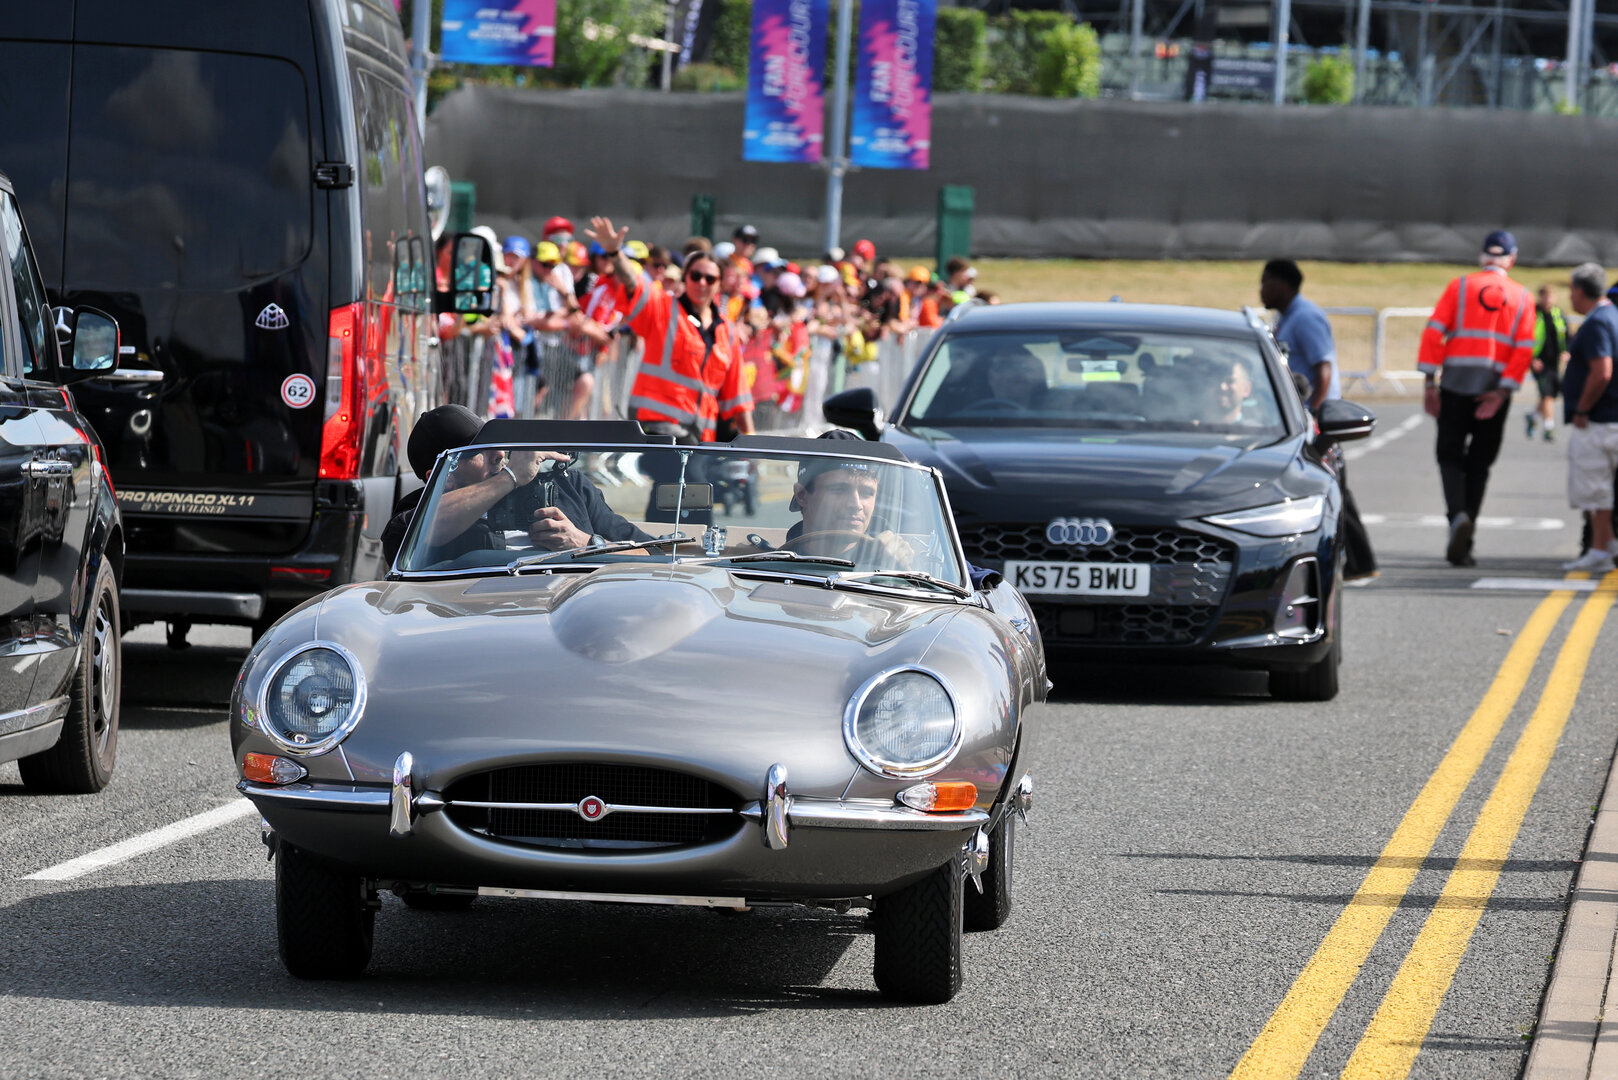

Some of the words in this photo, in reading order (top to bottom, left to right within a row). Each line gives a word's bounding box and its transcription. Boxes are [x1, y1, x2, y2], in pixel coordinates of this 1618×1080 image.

[763, 55, 786, 96] FAN
[869, 61, 892, 102] FAN
[287, 385, 308, 398] 62
[147, 492, 217, 505] MONACO
[141, 503, 163, 512] BY
[168, 504, 226, 514] CIVILISED
[1015, 565, 1081, 589] KS75
[1089, 567, 1137, 590] BWU
